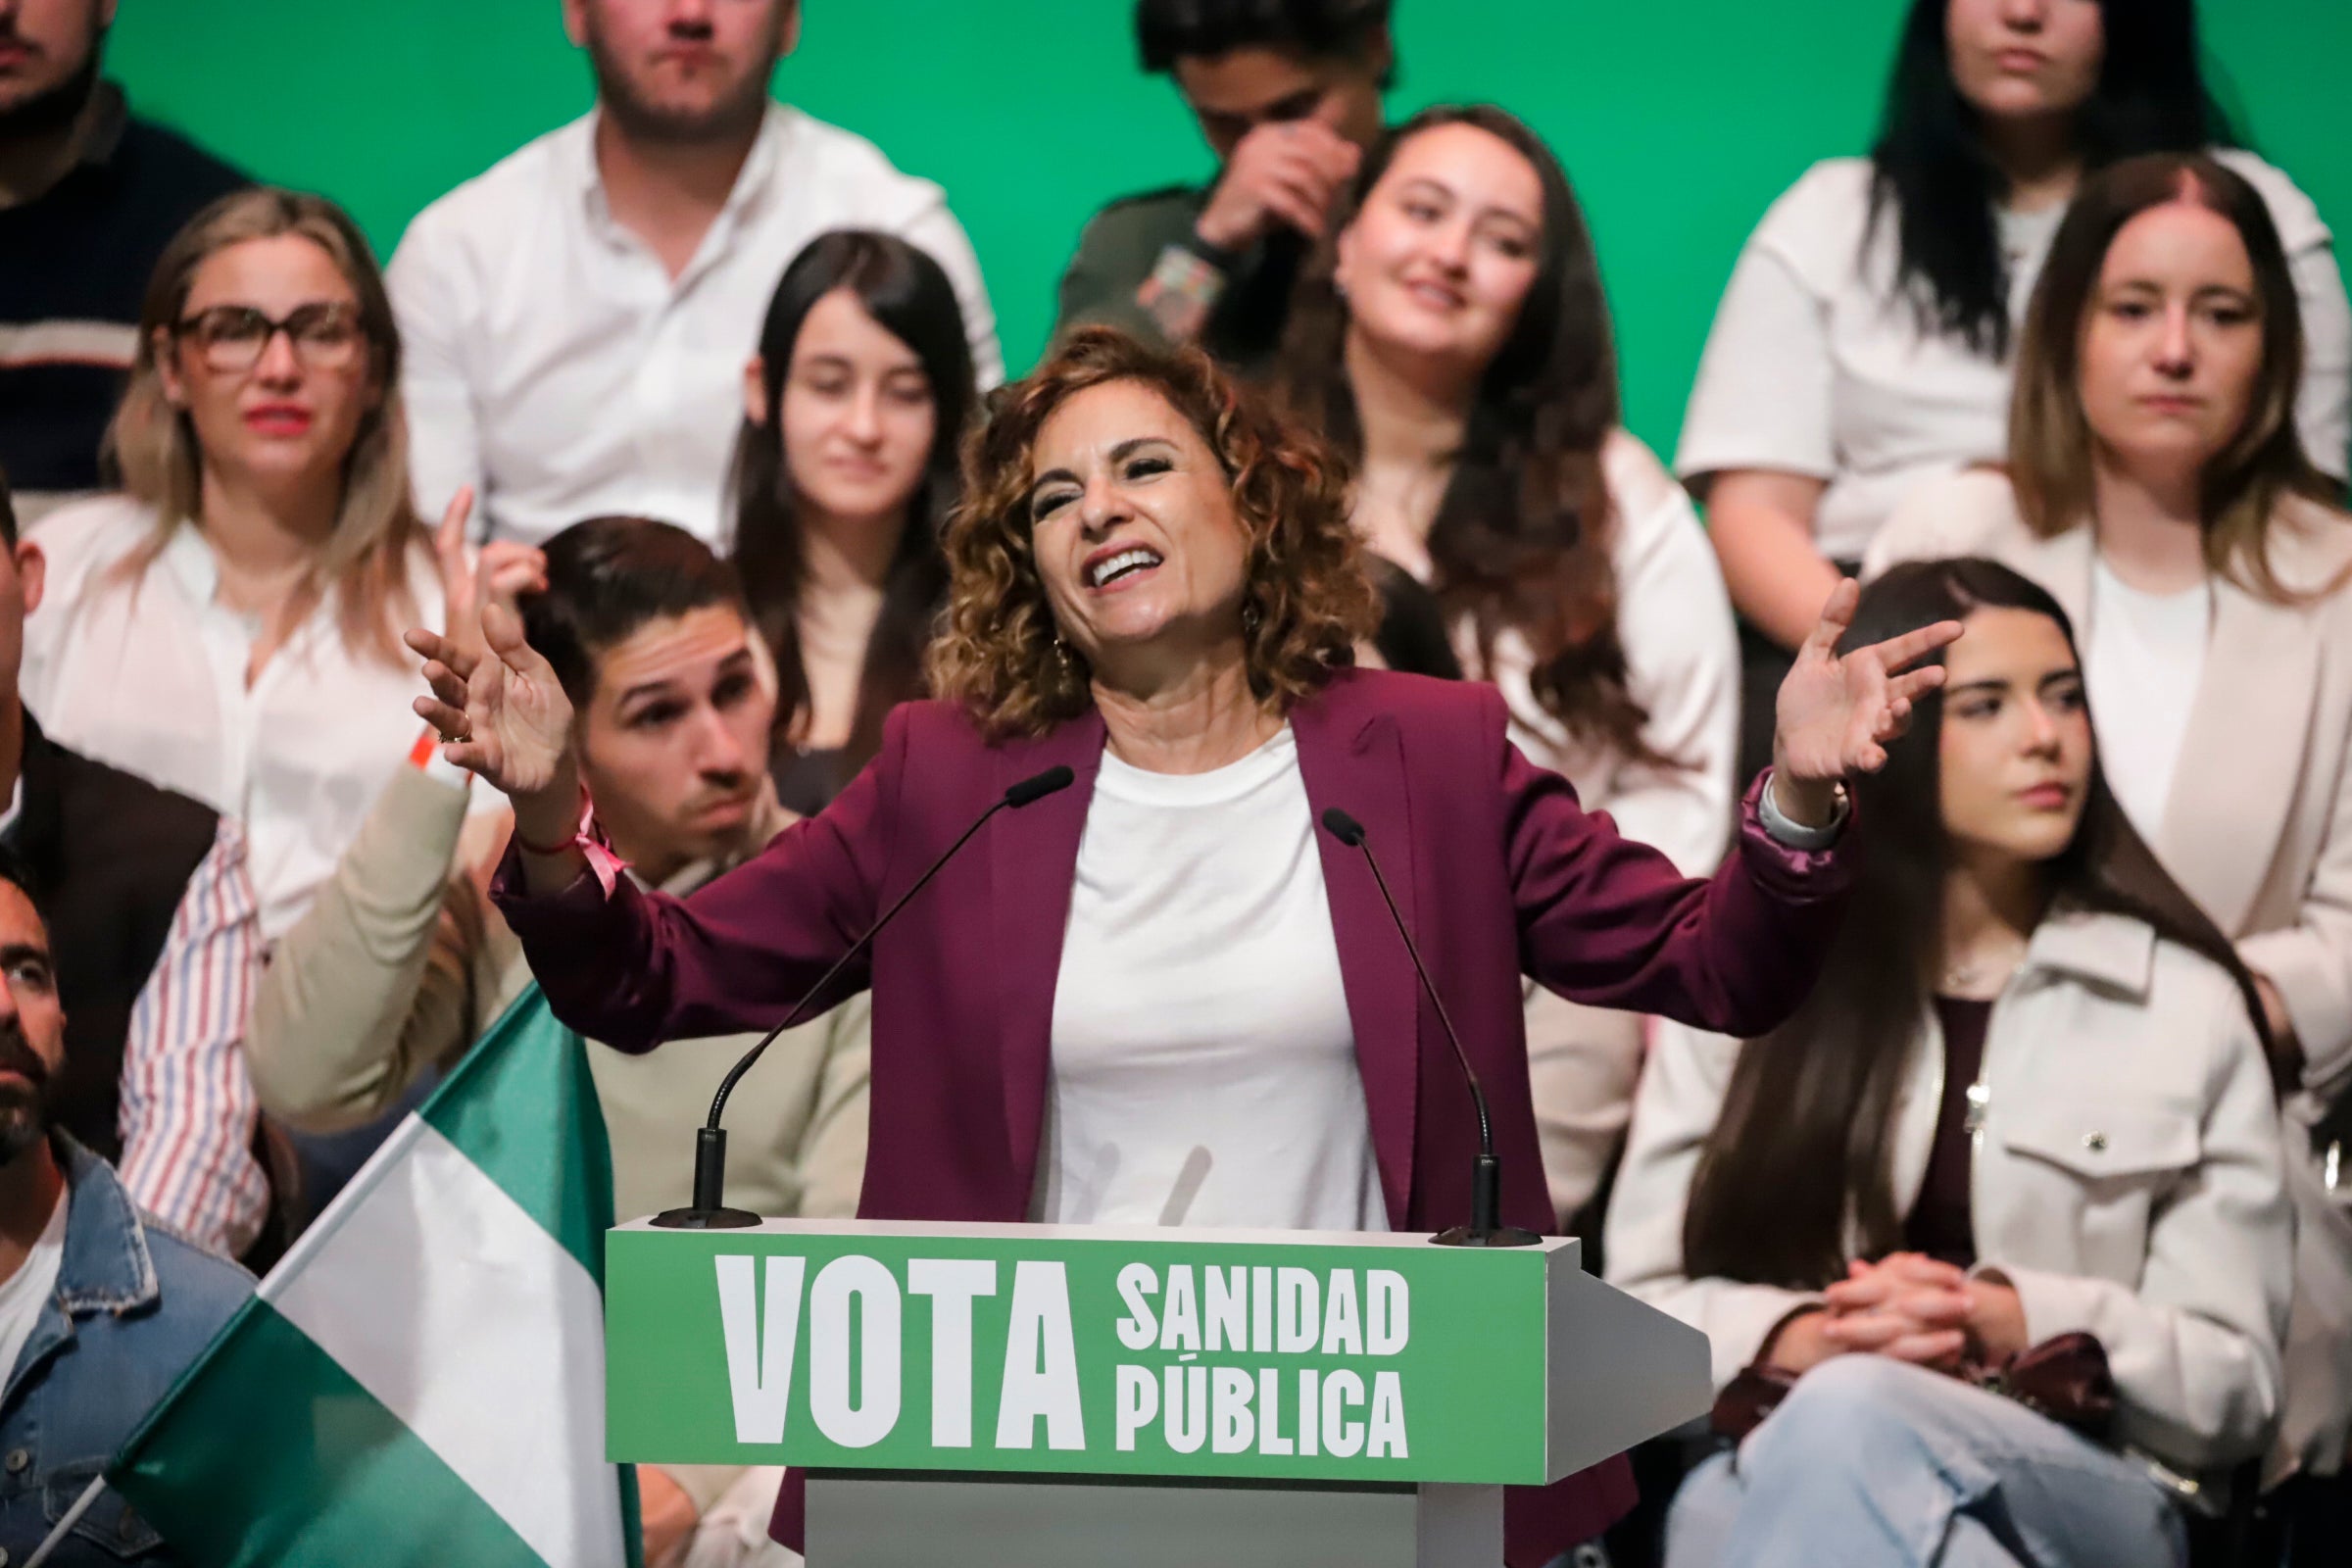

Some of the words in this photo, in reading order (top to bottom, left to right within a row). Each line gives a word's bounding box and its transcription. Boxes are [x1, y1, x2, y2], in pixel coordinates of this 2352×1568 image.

[714, 1254, 1087, 1451] VOTA
[1116, 1261, 1409, 1356] SANIDAD
[1115, 1352, 1409, 1459] PÚBLICA
